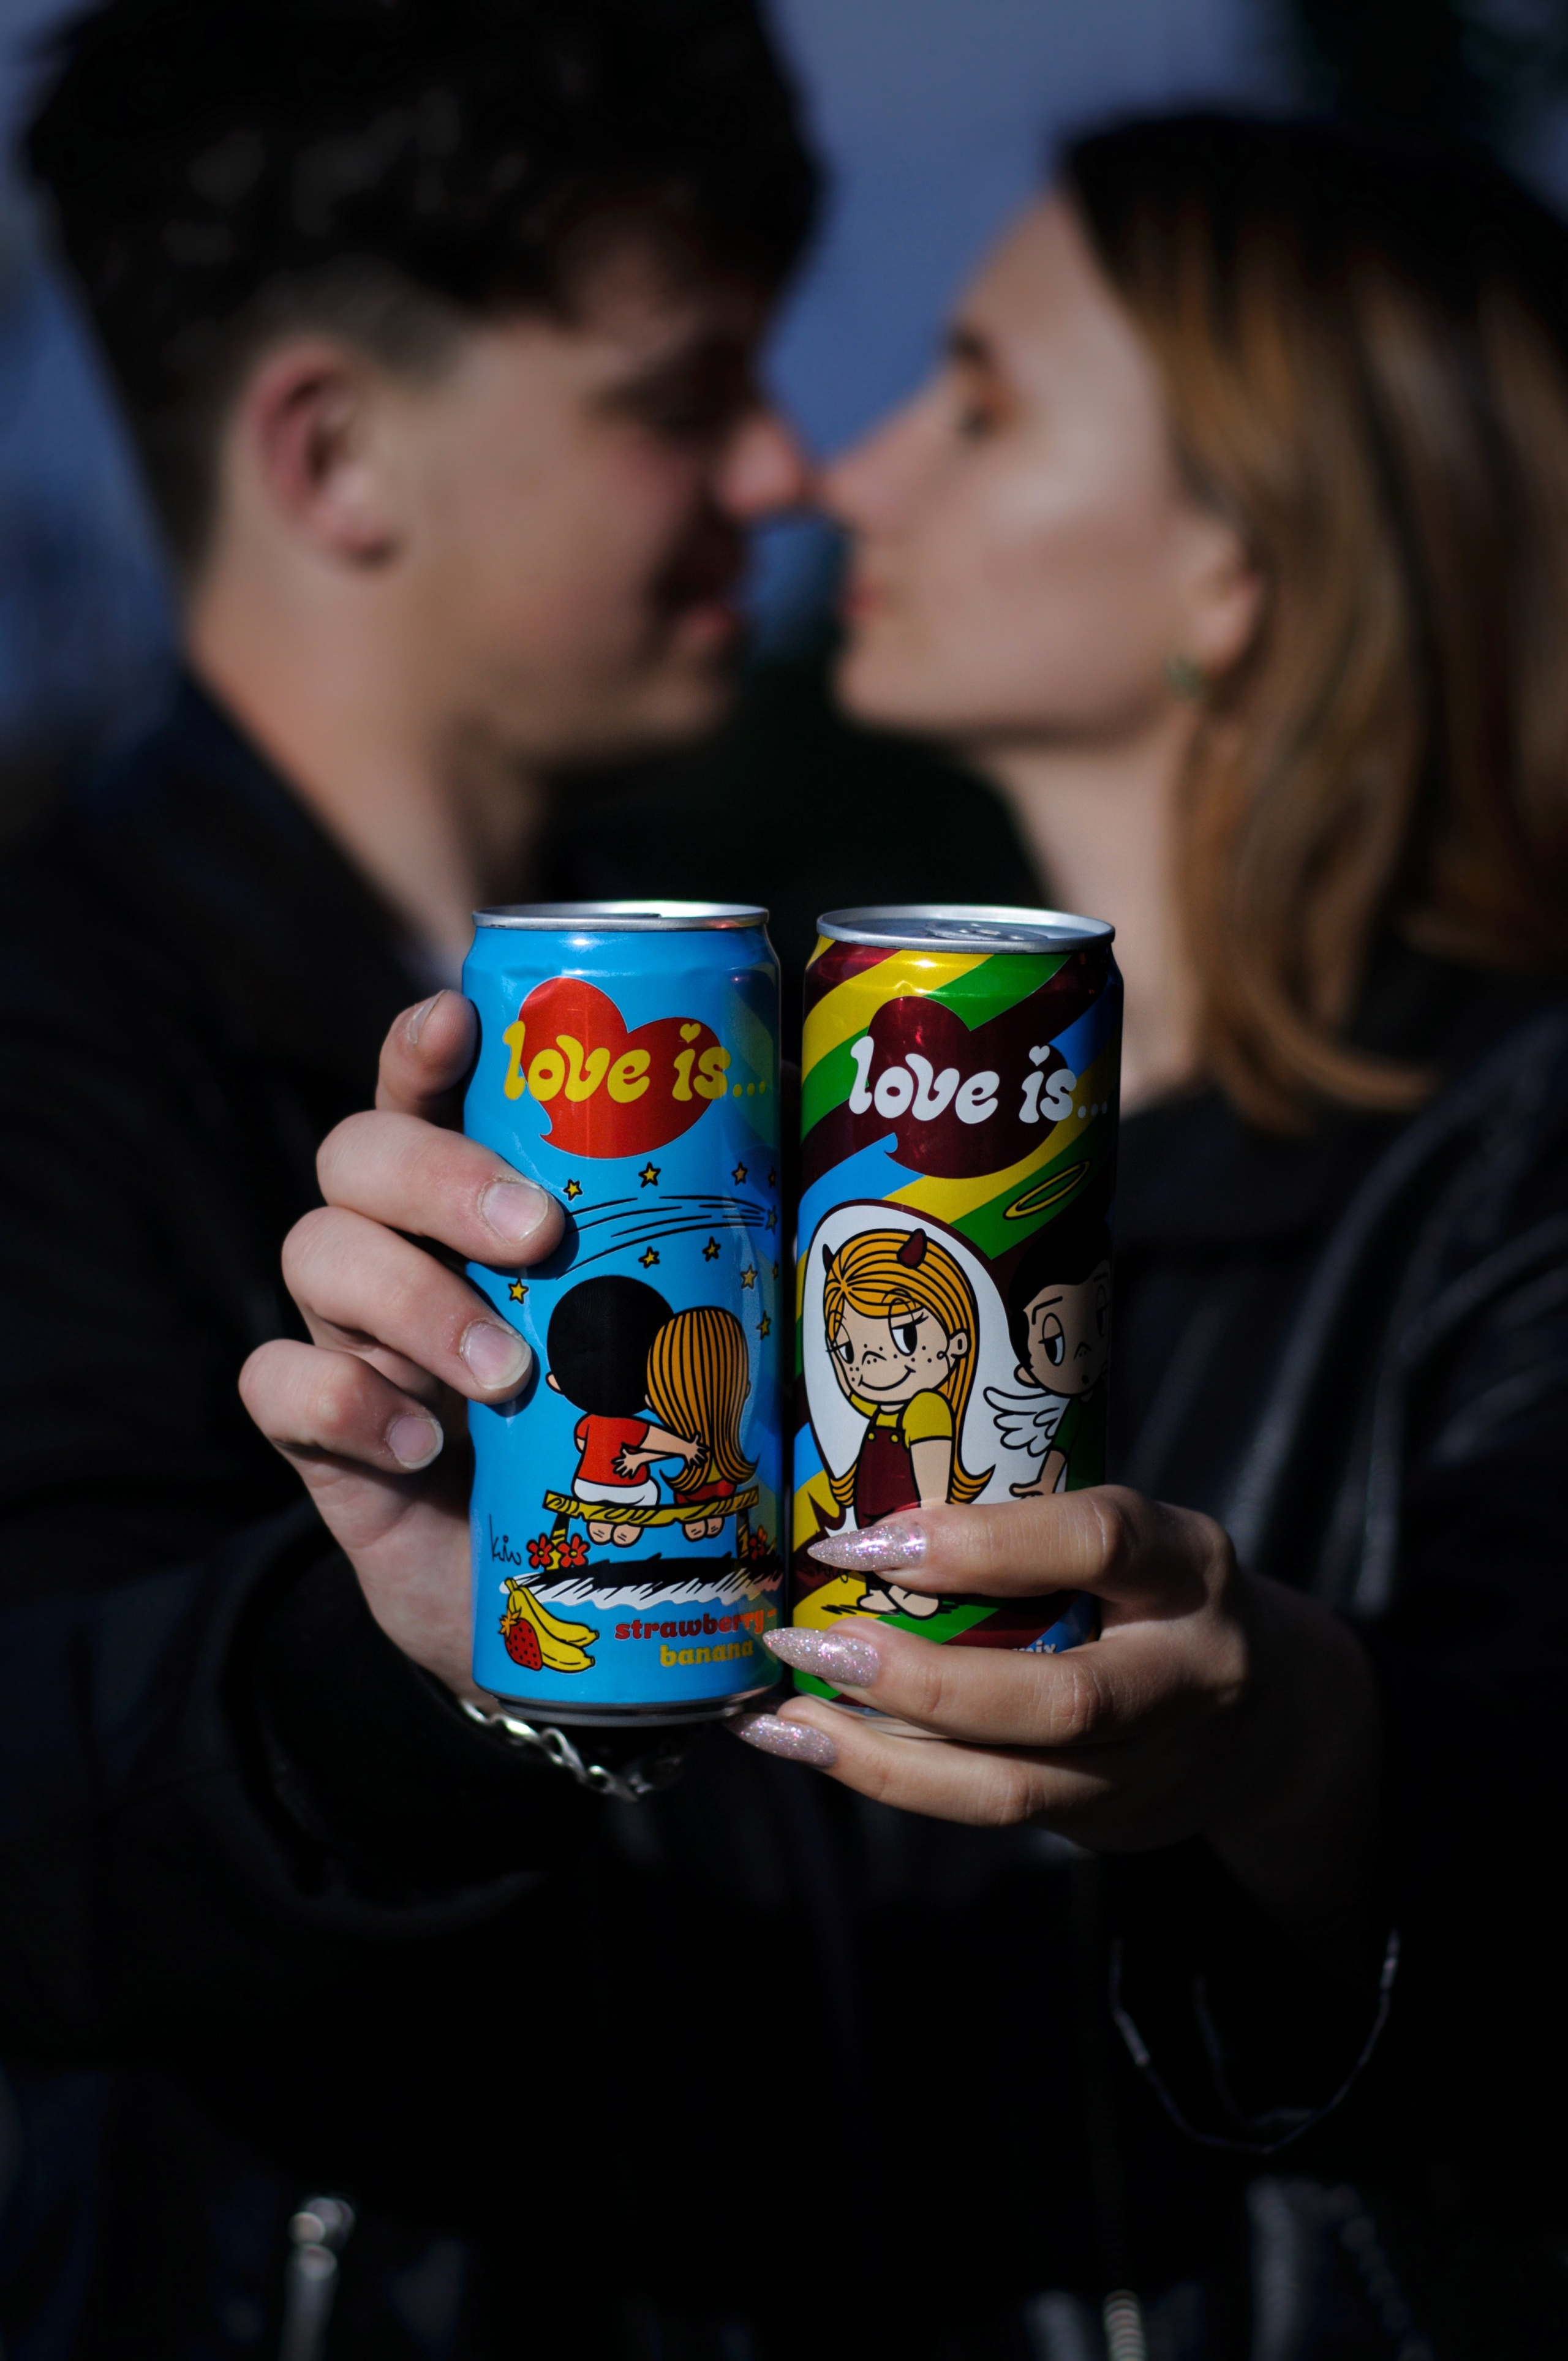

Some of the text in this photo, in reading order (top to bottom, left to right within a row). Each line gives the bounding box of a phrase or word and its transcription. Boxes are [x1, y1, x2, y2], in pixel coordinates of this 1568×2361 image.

[502, 1020, 651, 1104] love
[849, 1036, 1000, 1124] love
[660, 1640, 754, 1667] banana
[1011, 1640, 1057, 1654] ix
